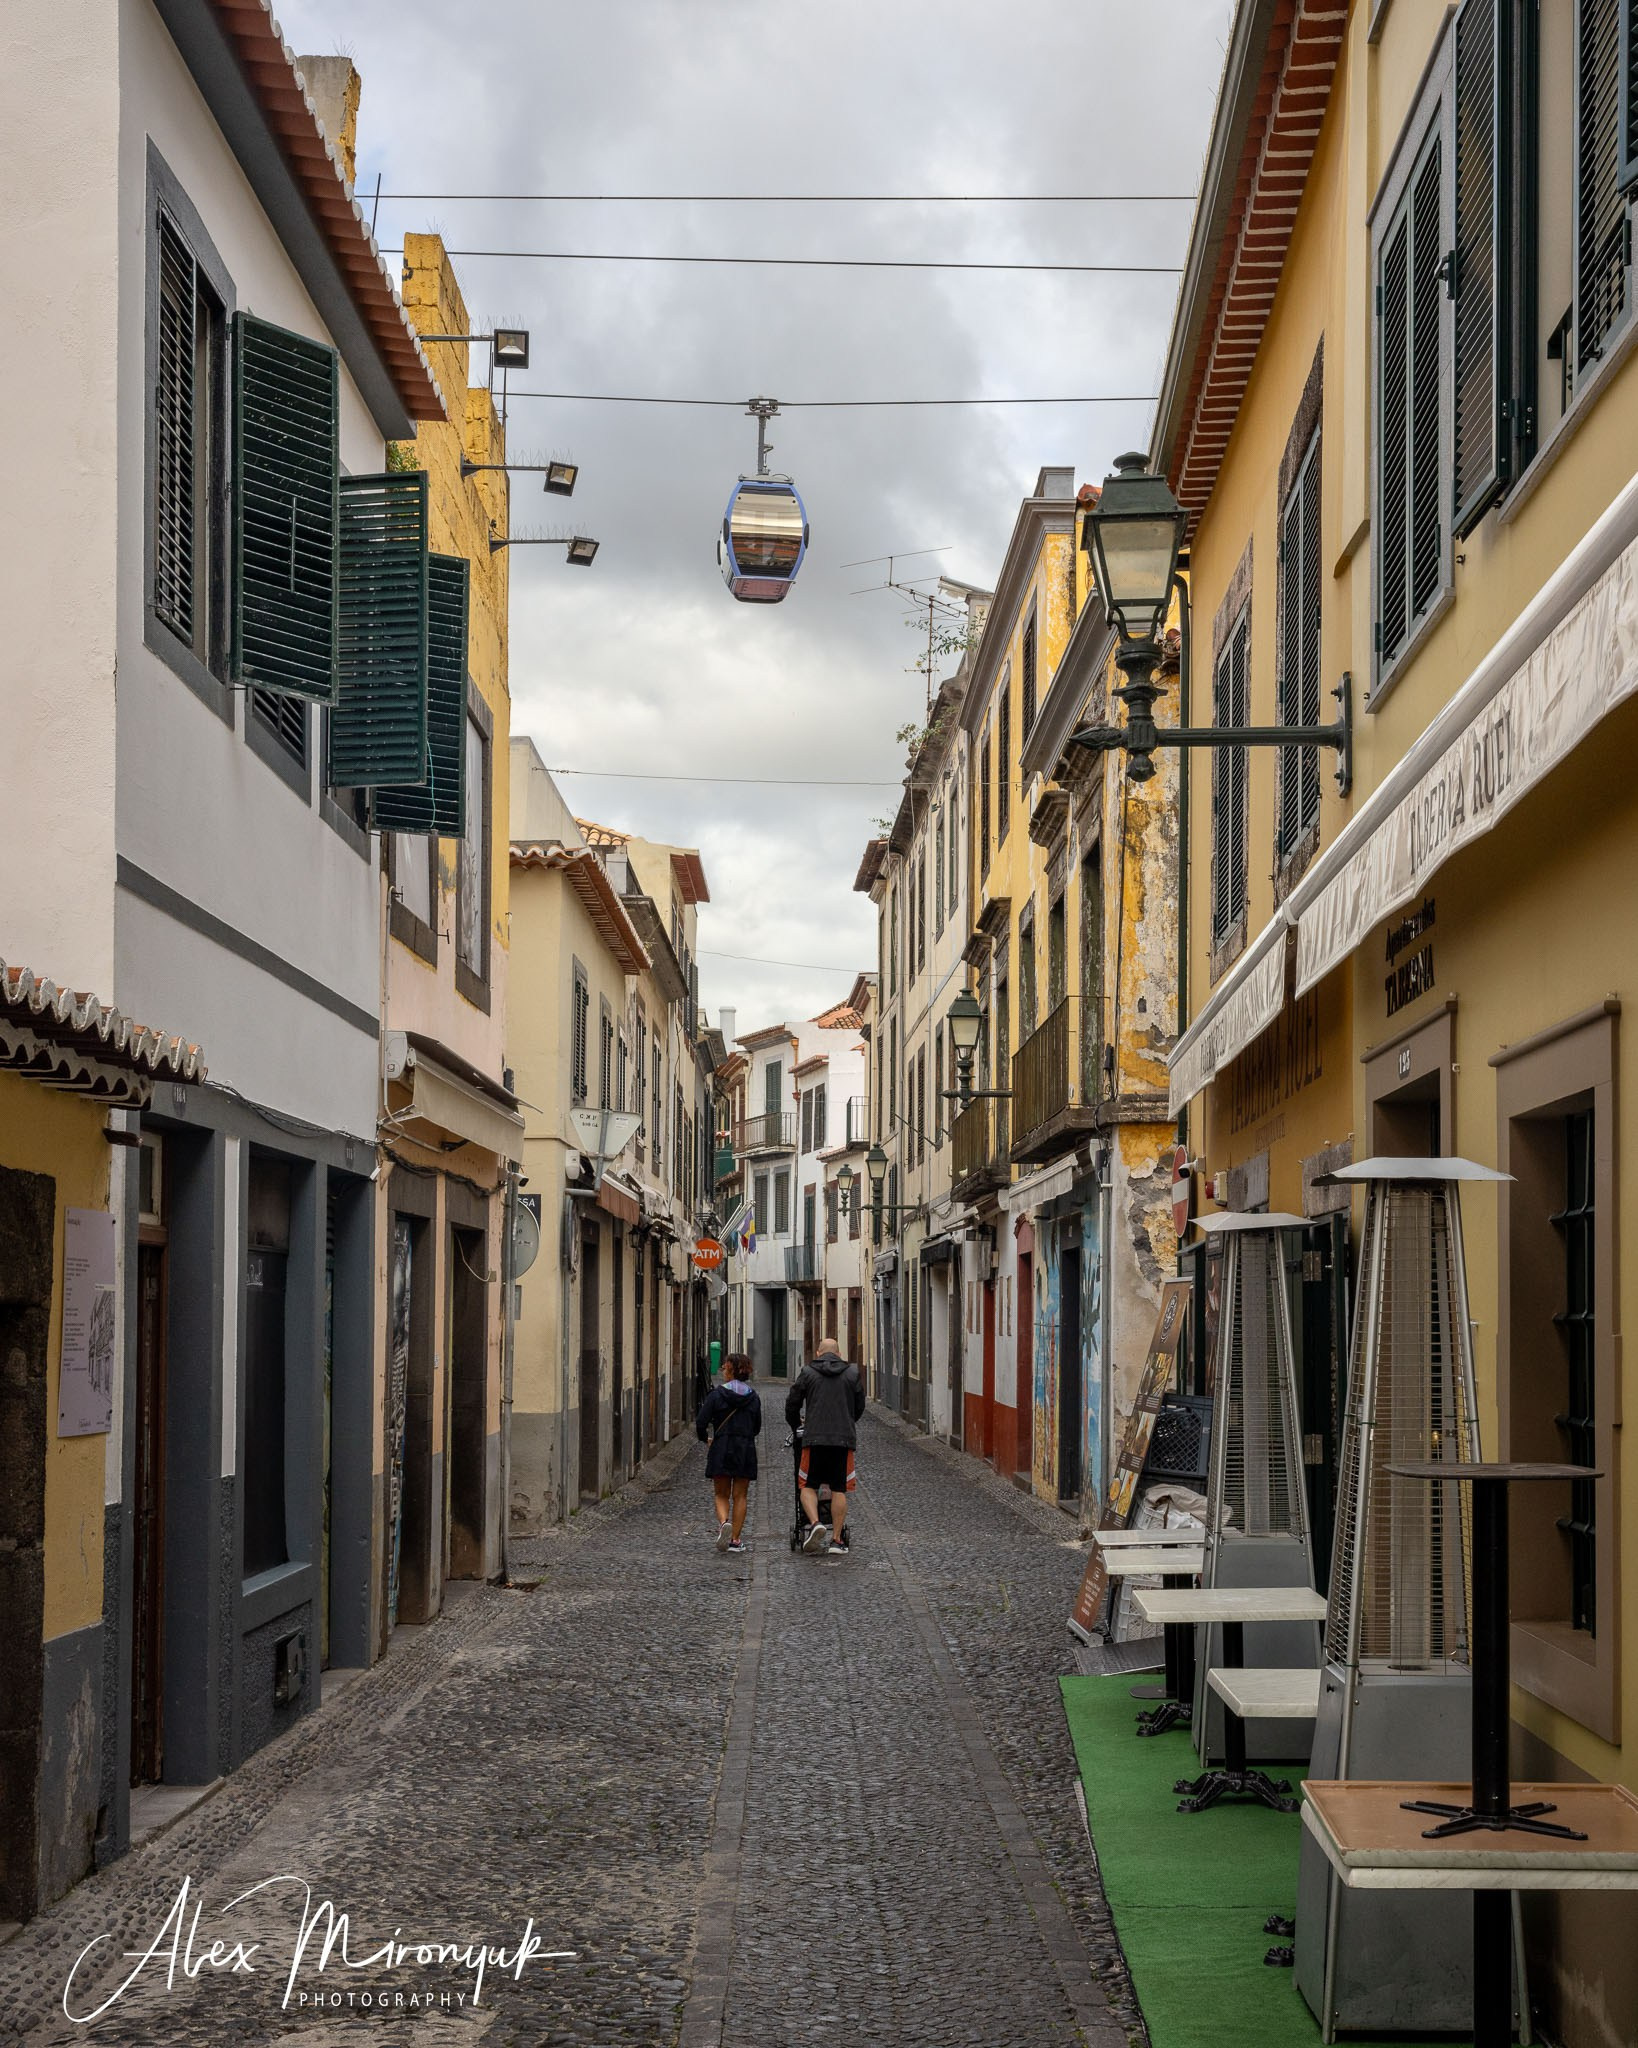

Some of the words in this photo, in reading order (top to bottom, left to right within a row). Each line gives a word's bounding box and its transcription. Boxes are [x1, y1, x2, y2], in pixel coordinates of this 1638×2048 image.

[1410, 758, 1466, 876] TABERNA
[1385, 943, 1436, 1018] TABERNA
[694, 1248, 720, 1260] ATM
